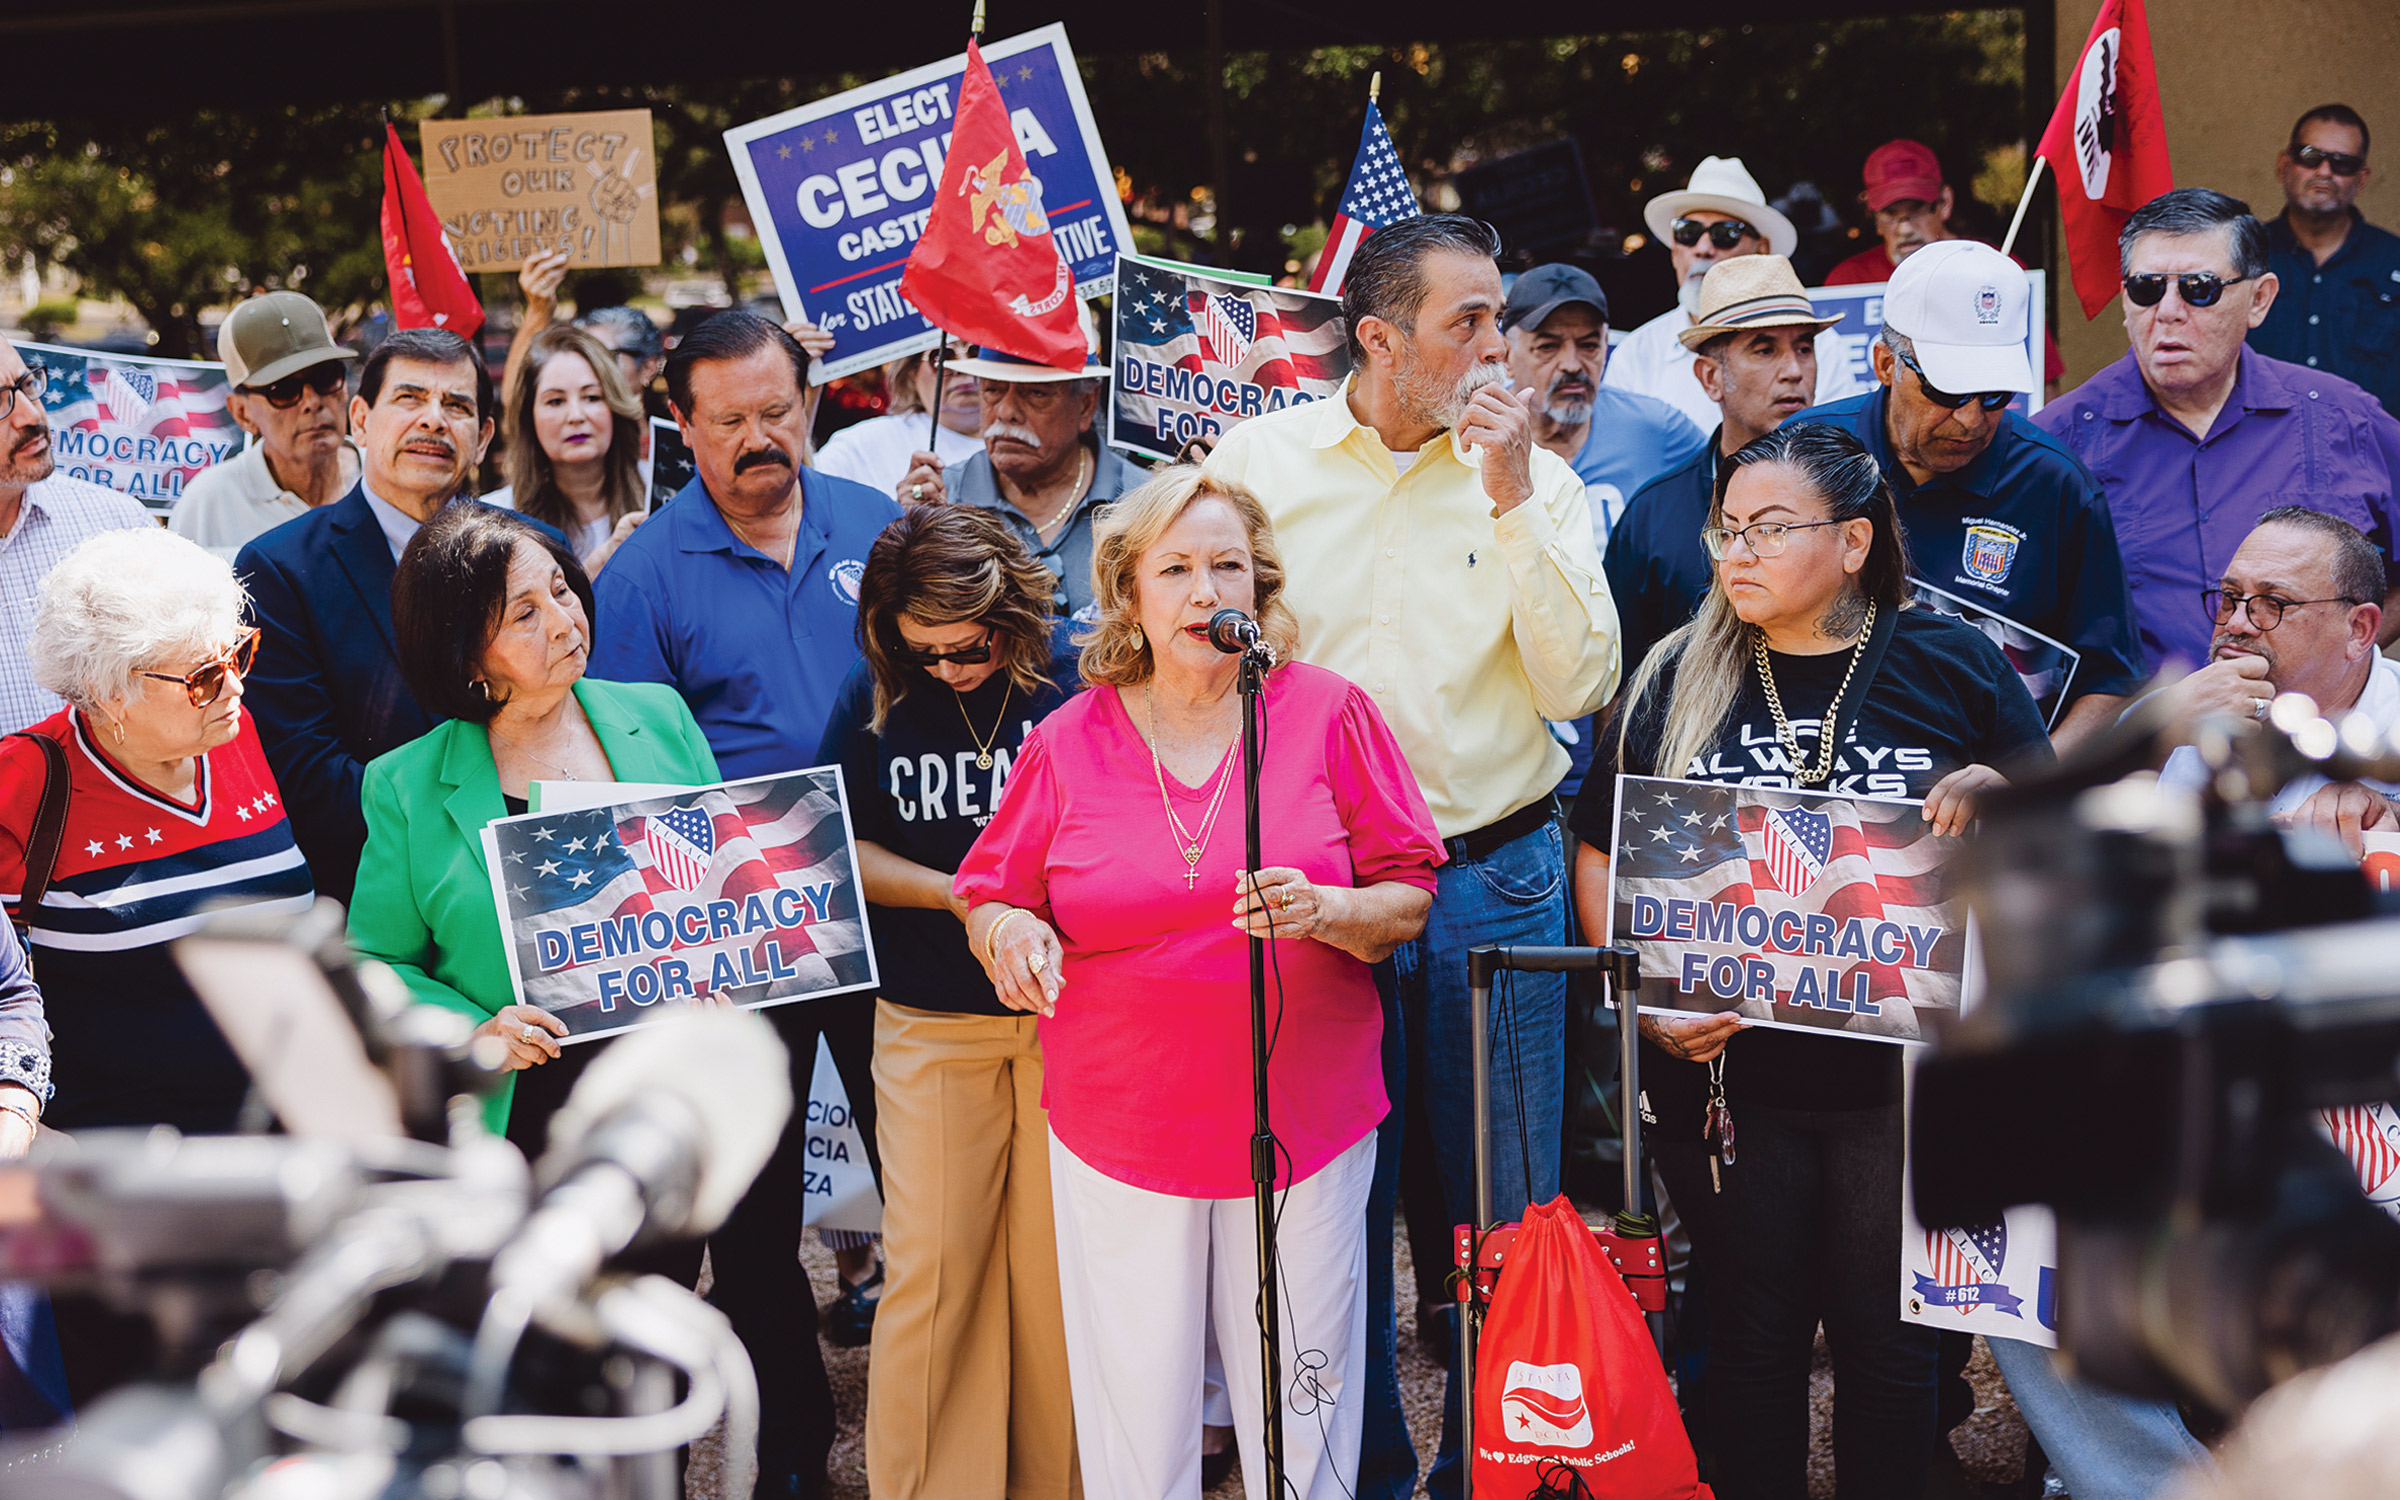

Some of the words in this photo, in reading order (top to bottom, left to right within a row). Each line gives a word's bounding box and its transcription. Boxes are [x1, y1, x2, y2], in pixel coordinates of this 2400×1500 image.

[853, 82, 953, 146] ELECT
[440, 128, 625, 172] PROTECT
[796, 106, 1058, 229] CECIA
[502, 168, 576, 198] OUR
[443, 205, 582, 239] VOTING
[817, 311, 848, 333] for
[1123, 355, 1328, 418] DEMOCRA
[50, 428, 230, 467] MOCRACY
[127, 471, 184, 499] ALL
[1961, 516, 1984, 526] Miguel
[1954, 575, 1985, 589] Memorial
[1985, 582, 2010, 597] Chapter
[889, 744, 1022, 822] CREA
[652, 823, 707, 862] LULAC
[1772, 818, 1818, 872] LULAC
[534, 879, 835, 972] DEMOCRACY
[1631, 893, 1943, 969] DEMOCRACY
[597, 957, 697, 1013] FOR
[708, 940, 799, 994] ALL
[1679, 951, 1777, 1003] FOR
[1788, 964, 1882, 1017] ALL
[807, 1136, 850, 1163] CIA
[804, 1171, 832, 1197] ZA
[1950, 1227, 1993, 1281] ULAC
[1945, 1286, 1980, 1303] #612
[1479, 1447, 1493, 1461] We
[1560, 1454, 1594, 1467] Public
[1594, 1438, 1636, 1464] Schools!
